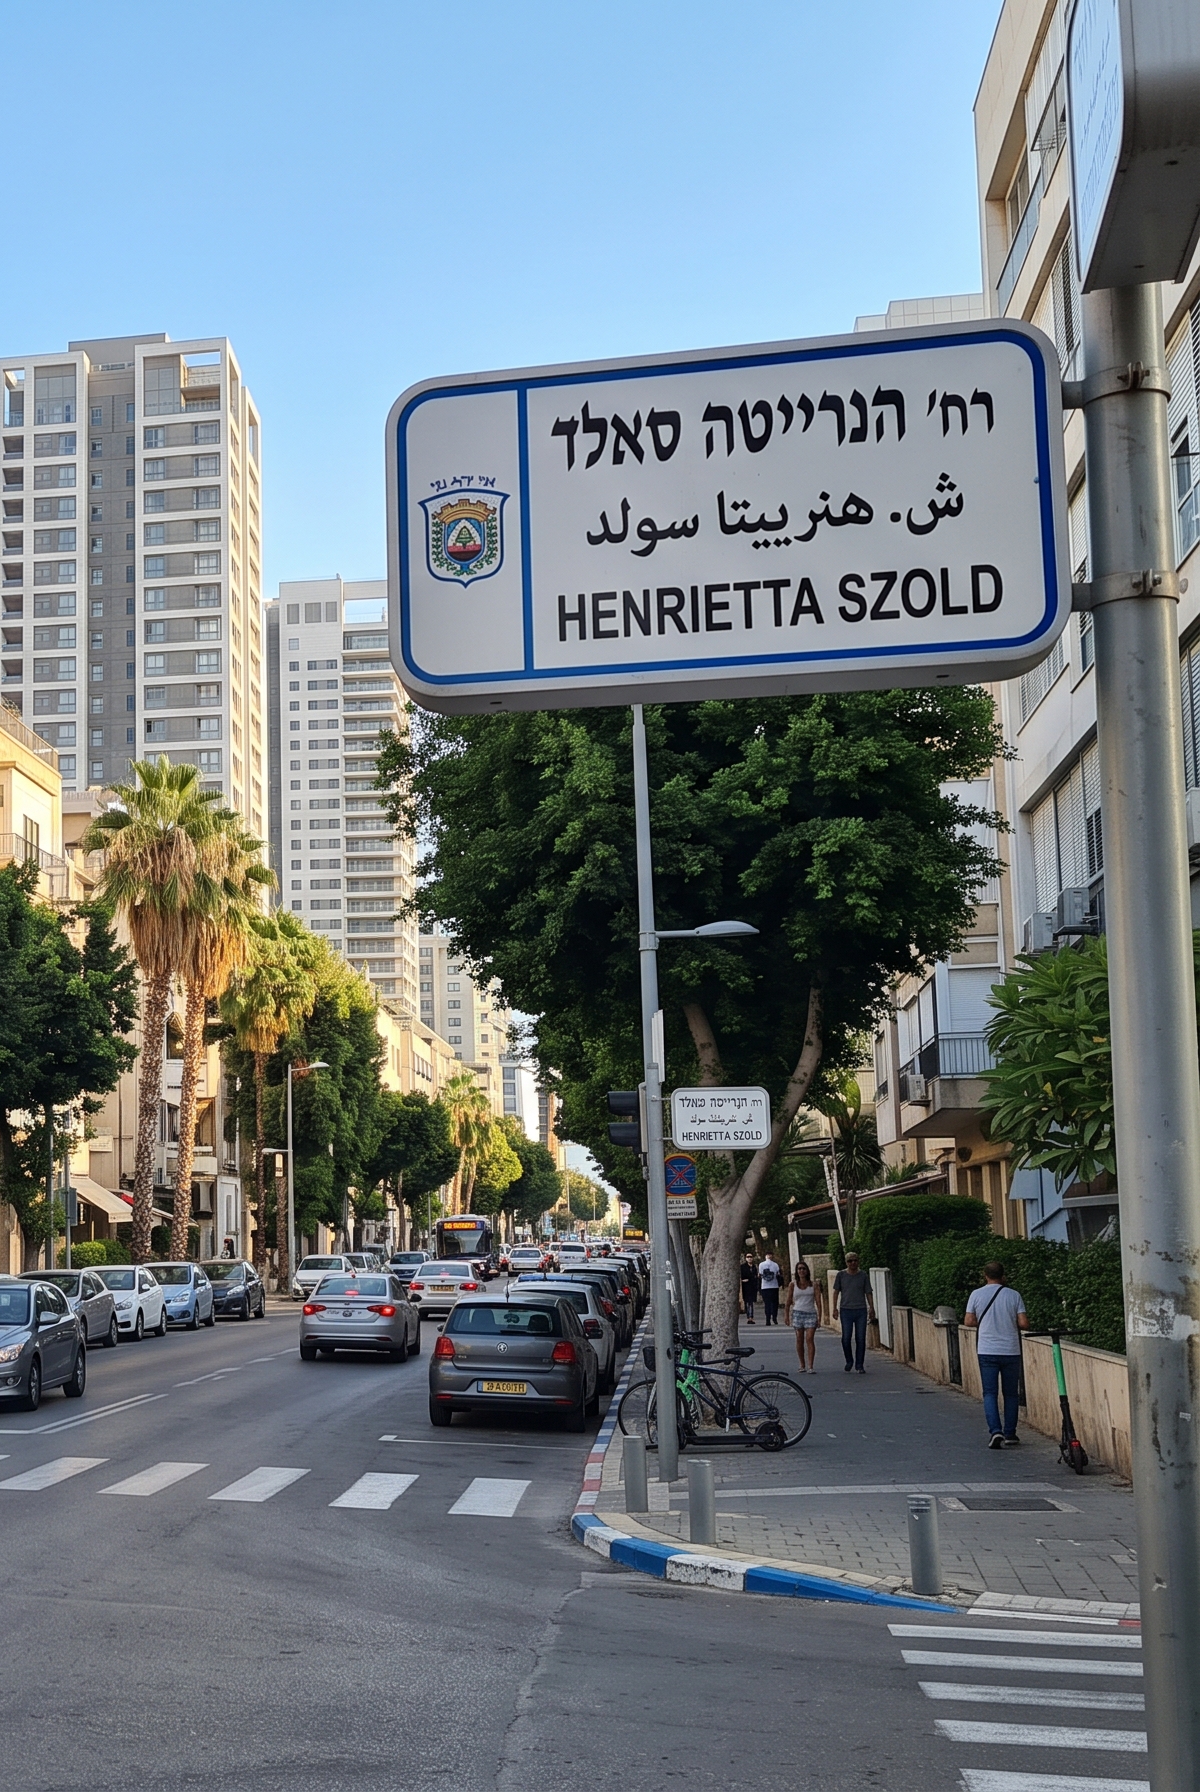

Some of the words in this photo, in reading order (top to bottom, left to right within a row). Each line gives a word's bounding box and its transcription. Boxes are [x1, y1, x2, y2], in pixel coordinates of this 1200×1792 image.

[550, 400, 682, 472] סאלד
[701, 384, 906, 460] הנרייטה
[586, 497, 700, 558] سولد
[716, 490, 874, 550] هنرييتا
[557, 577, 825, 642] HENRIETTA
[838, 564, 1003, 623] SZOLD
[682, 1131, 731, 1141] HENRIETTA
[733, 1130, 763, 1141] SZOLD
